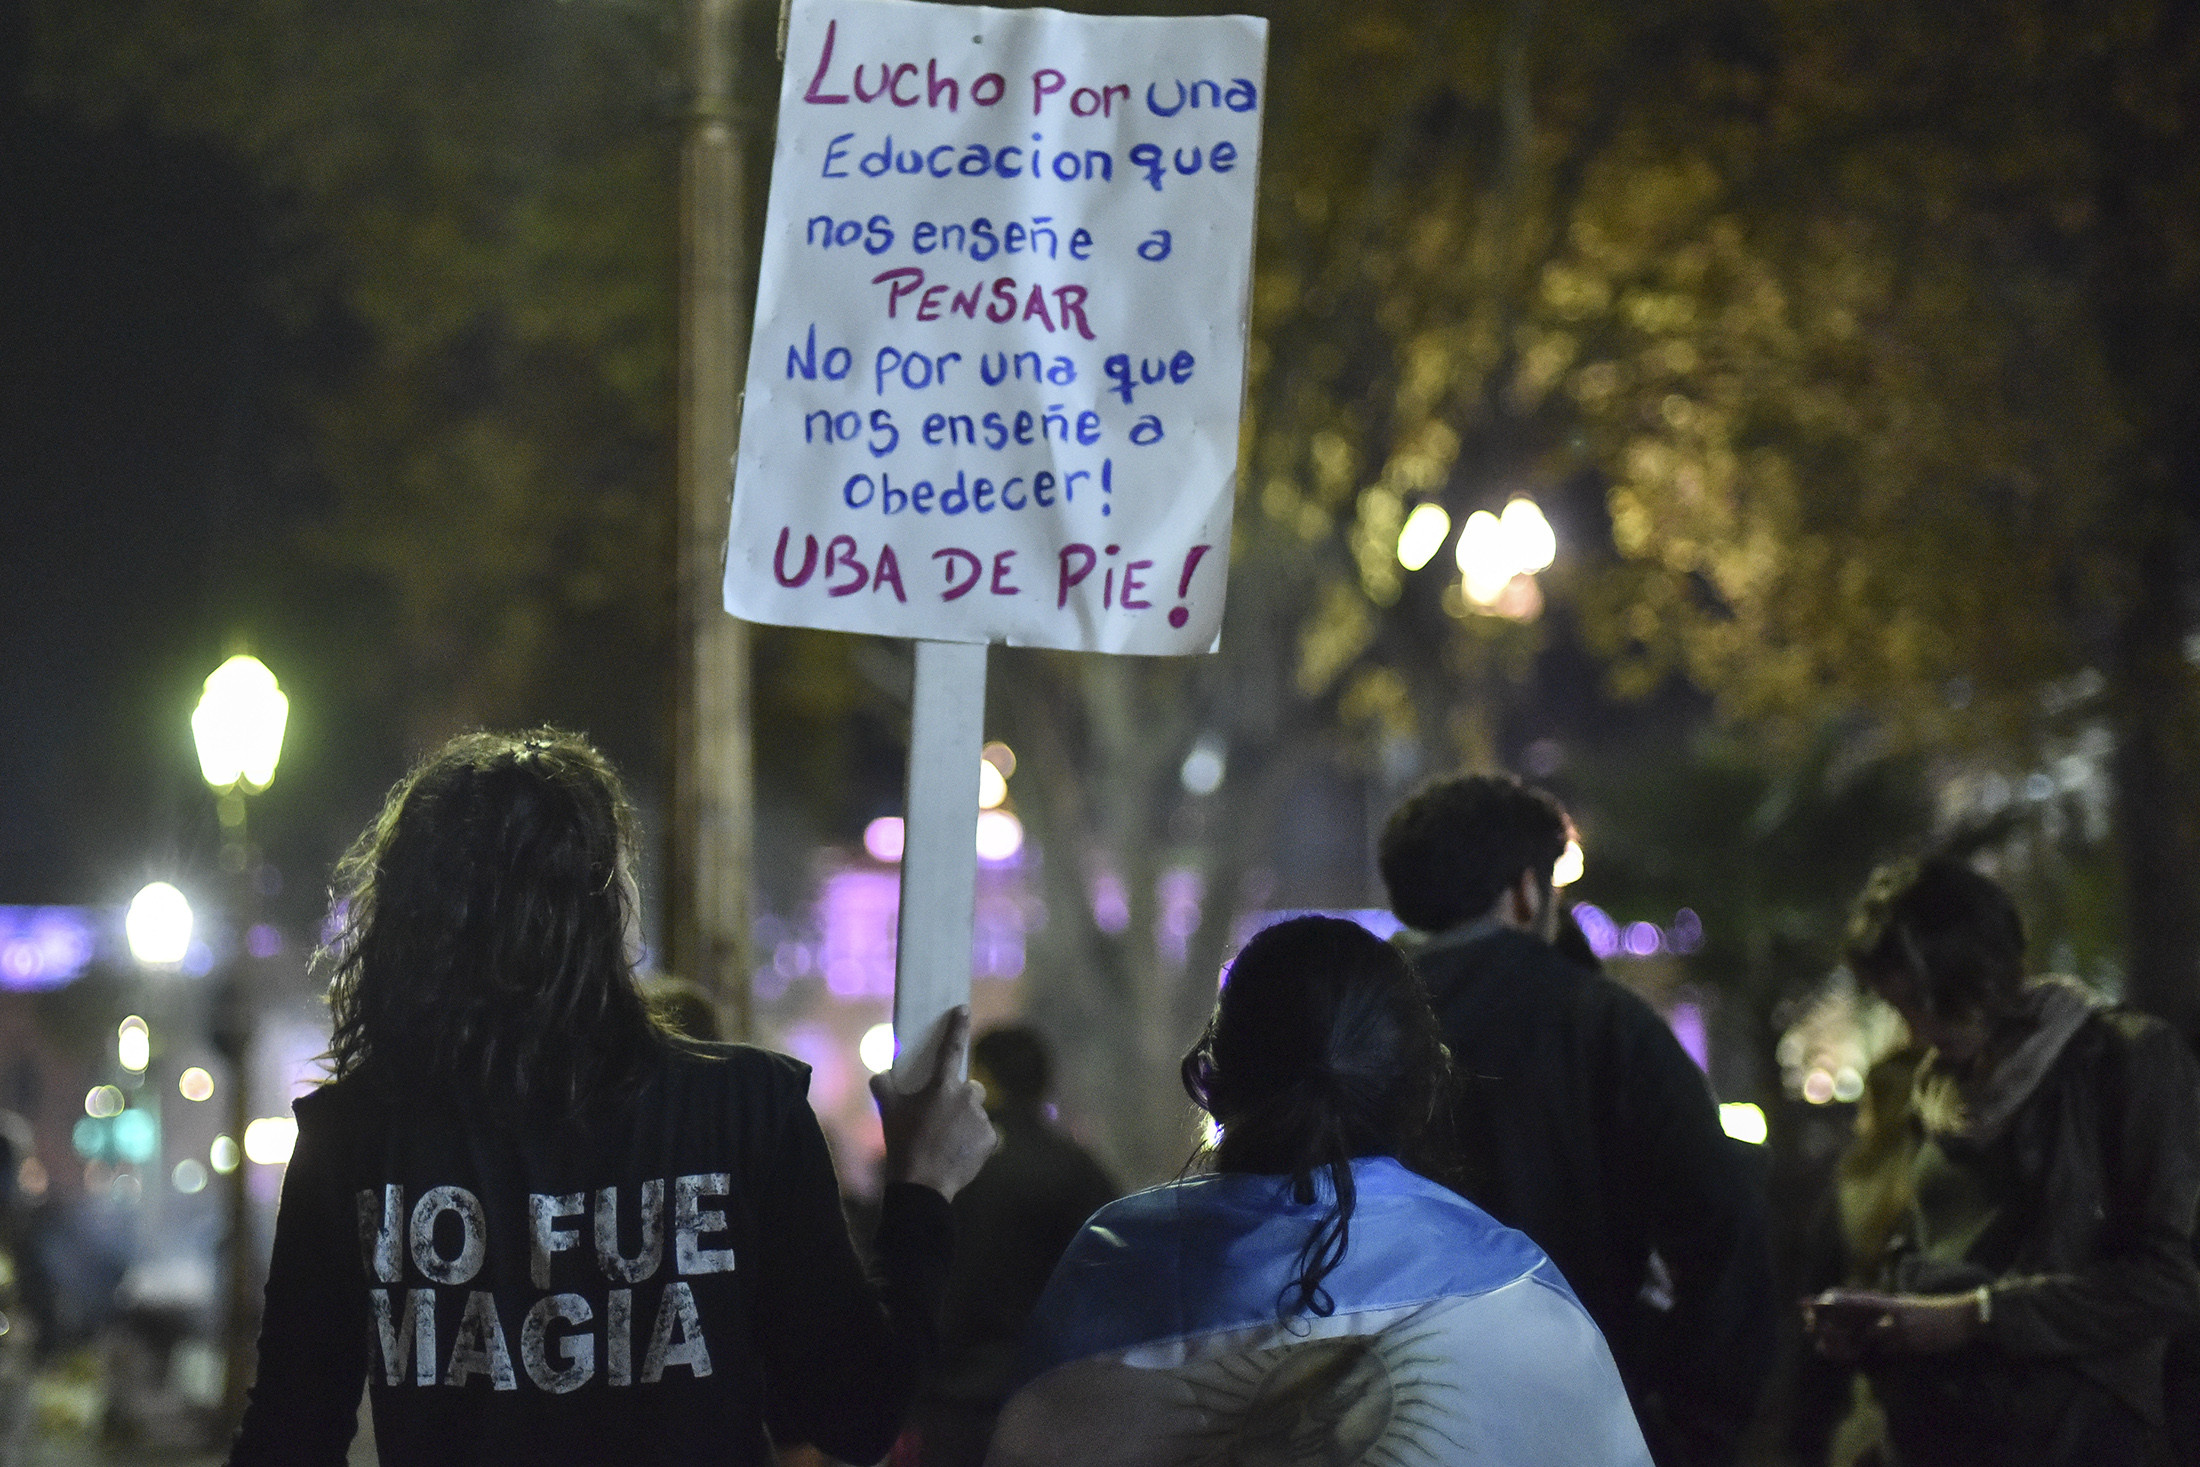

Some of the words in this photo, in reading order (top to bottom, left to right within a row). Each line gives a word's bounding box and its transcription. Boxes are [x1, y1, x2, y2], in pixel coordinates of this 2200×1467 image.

[803, 19, 1006, 113] Lucho
[1129, 141, 1237, 190] que
[806, 215, 894, 255] nos
[913, 217, 1093, 262] enseñe
[1138, 230, 1172, 261] a
[872, 267, 1097, 339] PENSAR
[787, 324, 852, 381] No
[876, 346, 962, 395] por
[980, 351, 1077, 387] una
[1104, 350, 1195, 404] que
[805, 408, 900, 457] nos
[922, 404, 1101, 450] enseñe
[1129, 415, 1164, 446] a
[773, 526, 906, 602] UBA
[932, 547, 1021, 602] DE
[529, 1172, 735, 1289] FUE
[370, 1282, 712, 1394] MAGIA
